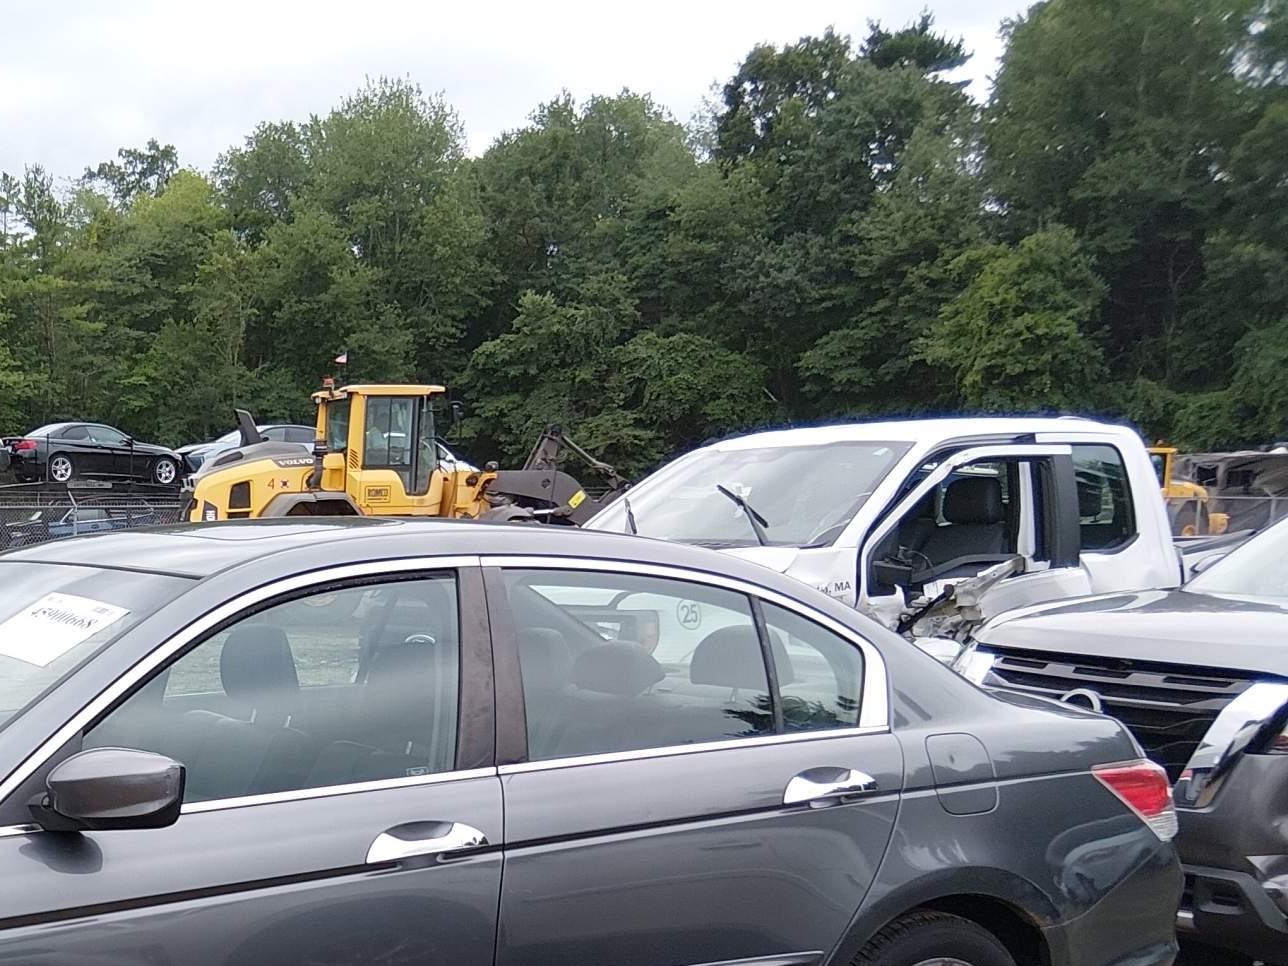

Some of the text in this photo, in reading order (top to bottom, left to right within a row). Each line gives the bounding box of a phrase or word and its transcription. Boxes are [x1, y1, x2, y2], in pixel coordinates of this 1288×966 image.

[278, 458, 314, 466] VOLVO
[267, 477, 275, 490] 4
[834, 581, 852, 592] MA
[680, 604, 698, 623] 25
